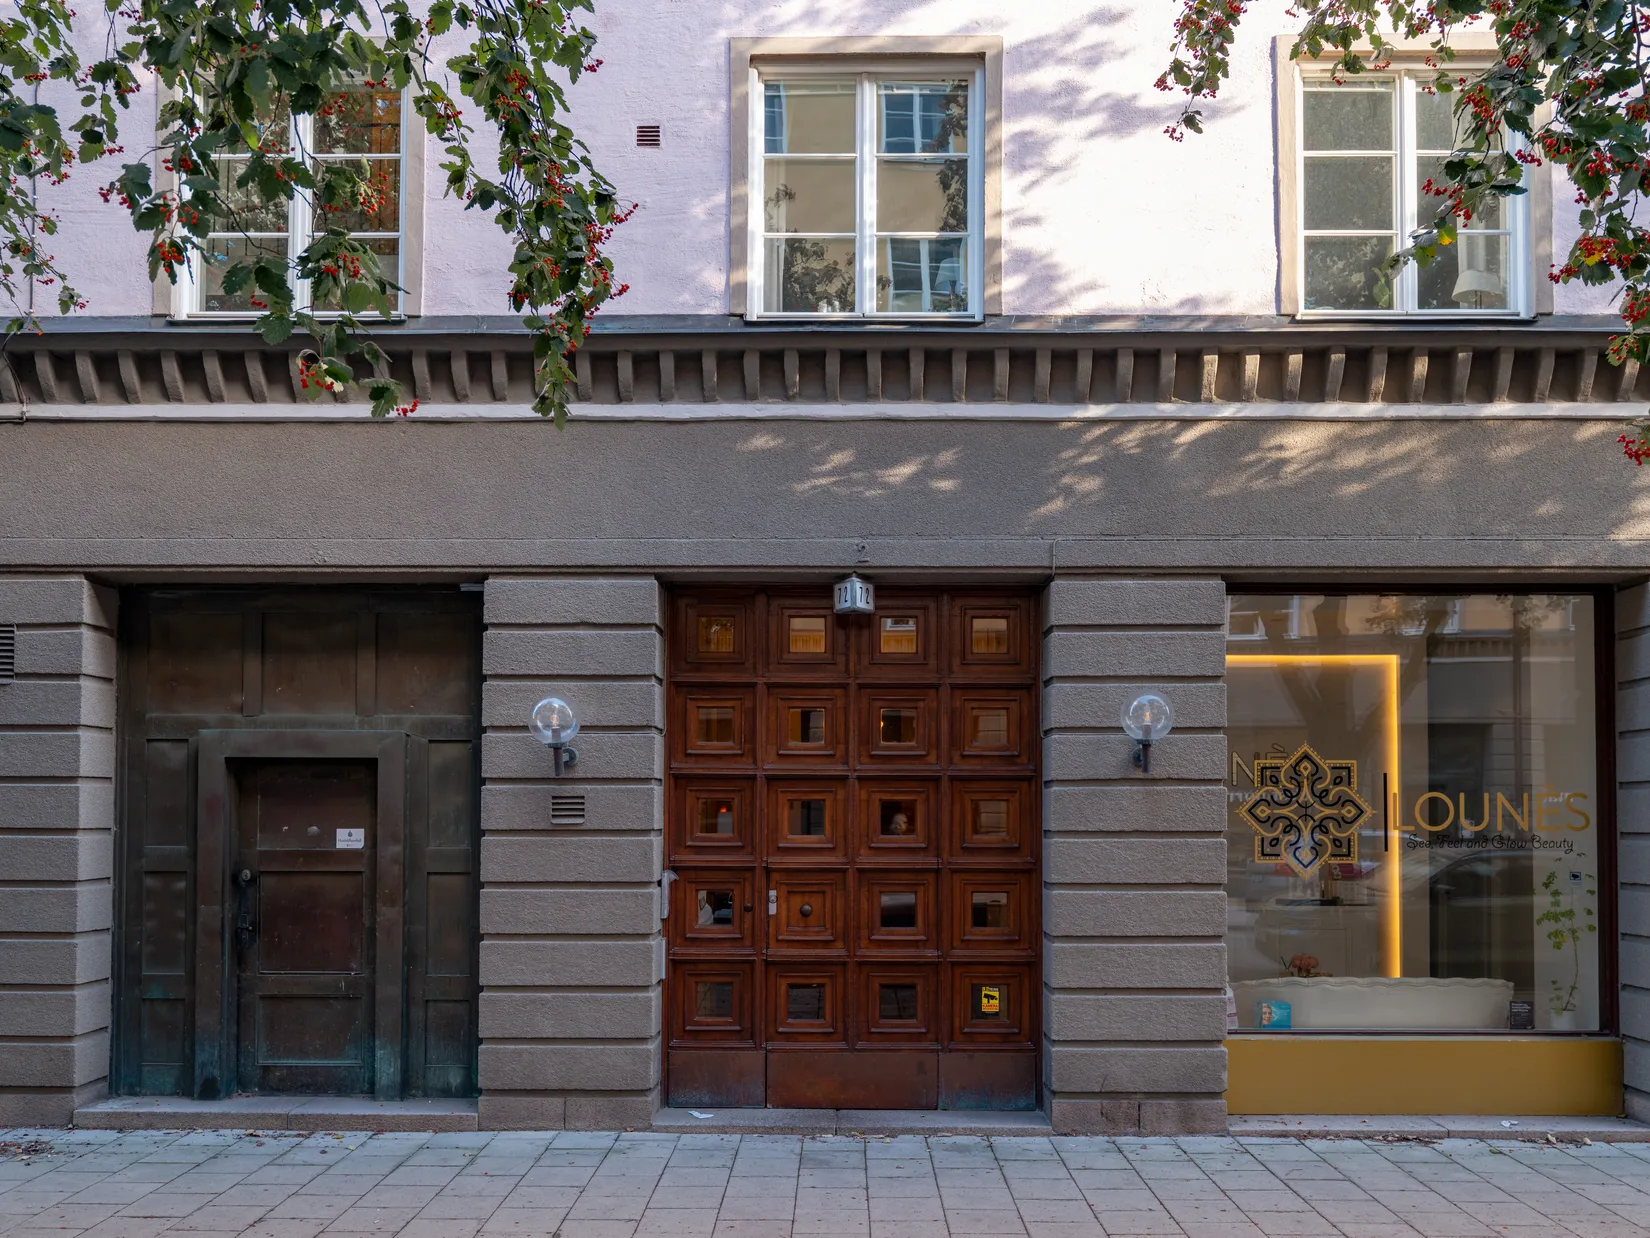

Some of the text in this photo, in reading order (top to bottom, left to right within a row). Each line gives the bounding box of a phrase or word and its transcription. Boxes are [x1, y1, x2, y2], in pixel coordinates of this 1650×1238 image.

[838, 586, 848, 604] 72
[859, 586, 870, 604] 72
[1392, 783, 1591, 832] LOUNÈS
[1437, 834, 1464, 849] Feel
[1466, 834, 1489, 849] and
[1491, 834, 1527, 849] Glow
[1531, 833, 1574, 855] Beauty
